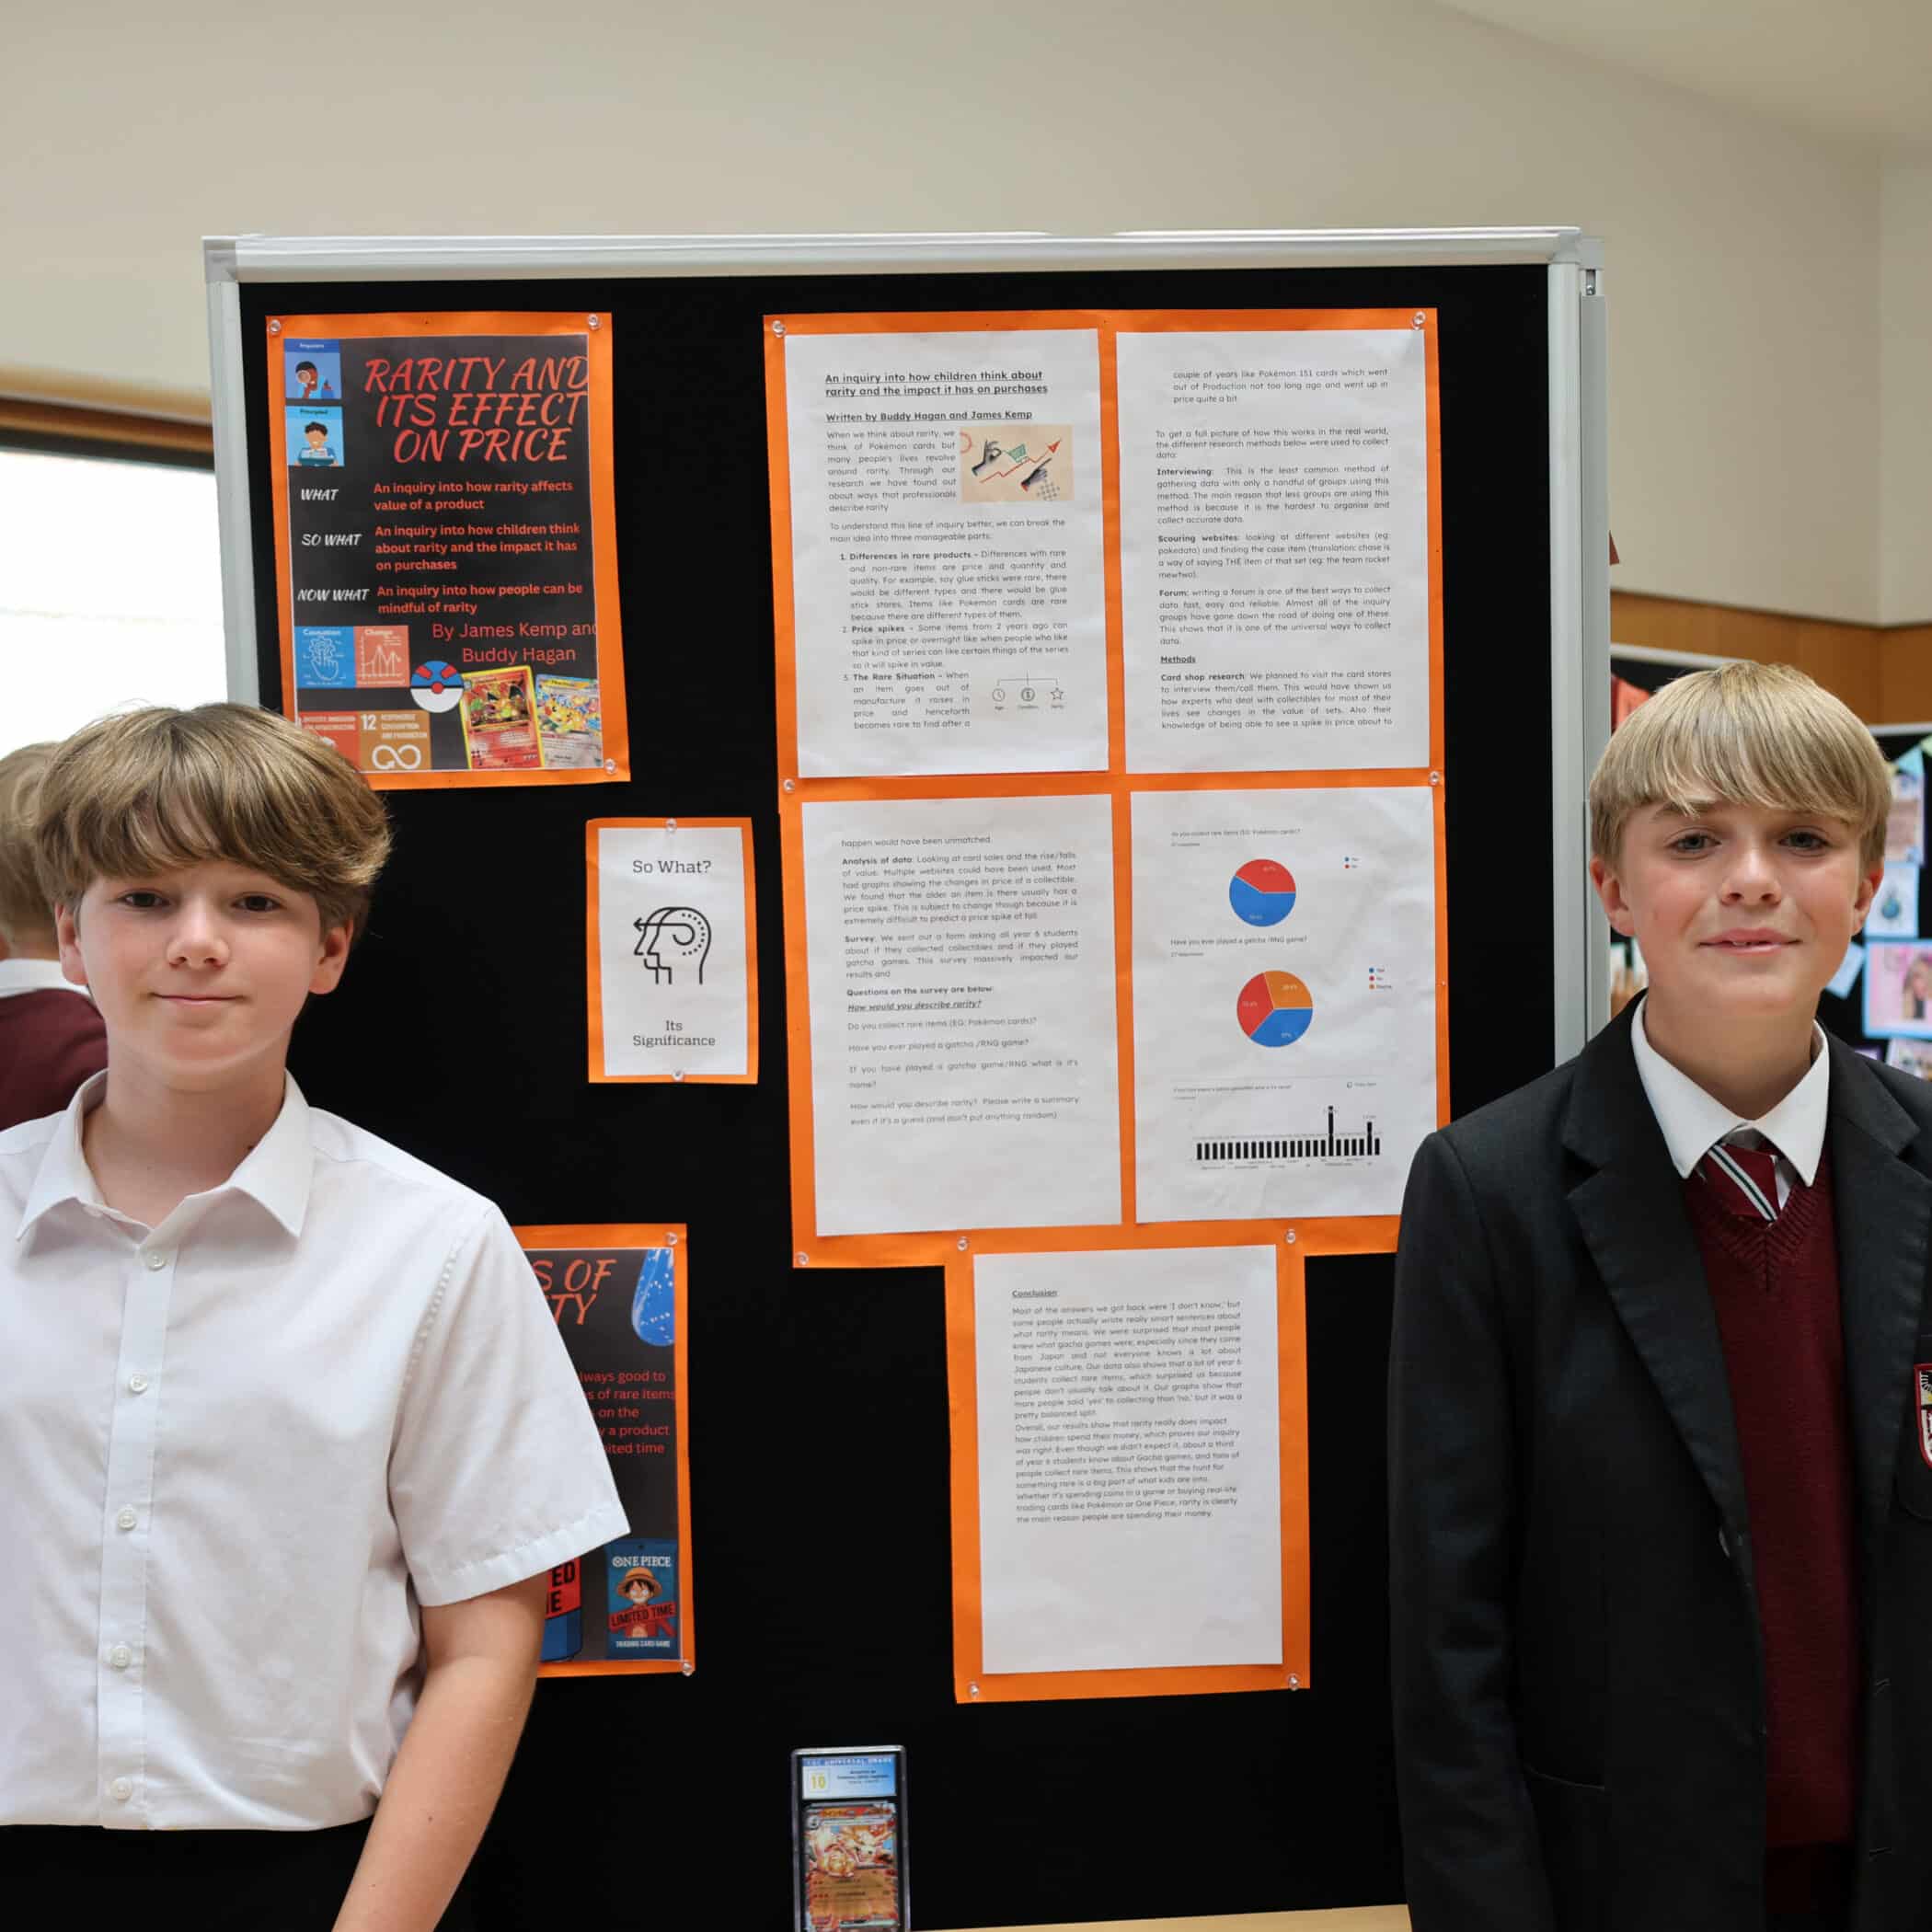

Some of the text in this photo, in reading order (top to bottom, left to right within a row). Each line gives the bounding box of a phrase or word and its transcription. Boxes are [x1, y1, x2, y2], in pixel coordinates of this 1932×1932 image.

[364, 356, 588, 393] RARITY AND
[825, 370, 1042, 385] An inquiry into how children think about
[825, 384, 1048, 399] rarity and the impact it has on purchases
[376, 391, 588, 427] ITS EFFECT
[826, 409, 1032, 423] Written by Buddy Hagan and James Kemp
[394, 427, 572, 463] ON PRICE
[301, 489, 339, 501] WHAT
[374, 480, 574, 497] An inquiry into how rarity affects
[374, 498, 484, 512] value of a product
[374, 523, 579, 539] An inquiry into how children think
[301, 534, 362, 546] SO WHAT
[1157, 534, 1196, 545] Scouring
[376, 540, 577, 557] about rarity and the impact it has
[848, 550, 897, 559] Differences
[900, 550, 909, 559] in
[933, 549, 972, 561] products
[376, 558, 456, 573] on purchases
[297, 589, 369, 601] NOW WHAT
[377, 582, 582, 600] An inquiry into how people can be
[379, 602, 477, 616] mindful of rarity
[432, 623, 453, 643] By
[461, 622, 515, 638] James
[518, 621, 568, 640] Kemp
[851, 624, 904, 635] Price spikes
[462, 645, 575, 667] Buddy Hagan
[1160, 654, 1196, 663] Methods
[853, 671, 935, 681] The Rare Situation
[1161, 672, 1181, 681] Card
[1184, 672, 1205, 683] shop
[361, 714, 376, 730] 12
[632, 860, 711, 873] So What?
[846, 987, 888, 998] Questions
[903, 986, 917, 995] the
[919, 987, 949, 996] survey
[665, 1019, 683, 1030] Its
[633, 1035, 715, 1049] Significance
[532, 1259, 618, 1293] S OF
[545, 1293, 598, 1326] TY
[580, 1371, 665, 1386] lways good to
[599, 1388, 611, 1399] of
[615, 1391, 639, 1399] rare
[598, 1406, 638, 1418] on the
[609, 1424, 670, 1439] a product
[606, 1442, 664, 1454] ited time
[612, 1555, 671, 1568] ONE PIECE
[552, 1561, 575, 1586] ED
[611, 1604, 673, 1627] LIMITED TIME
